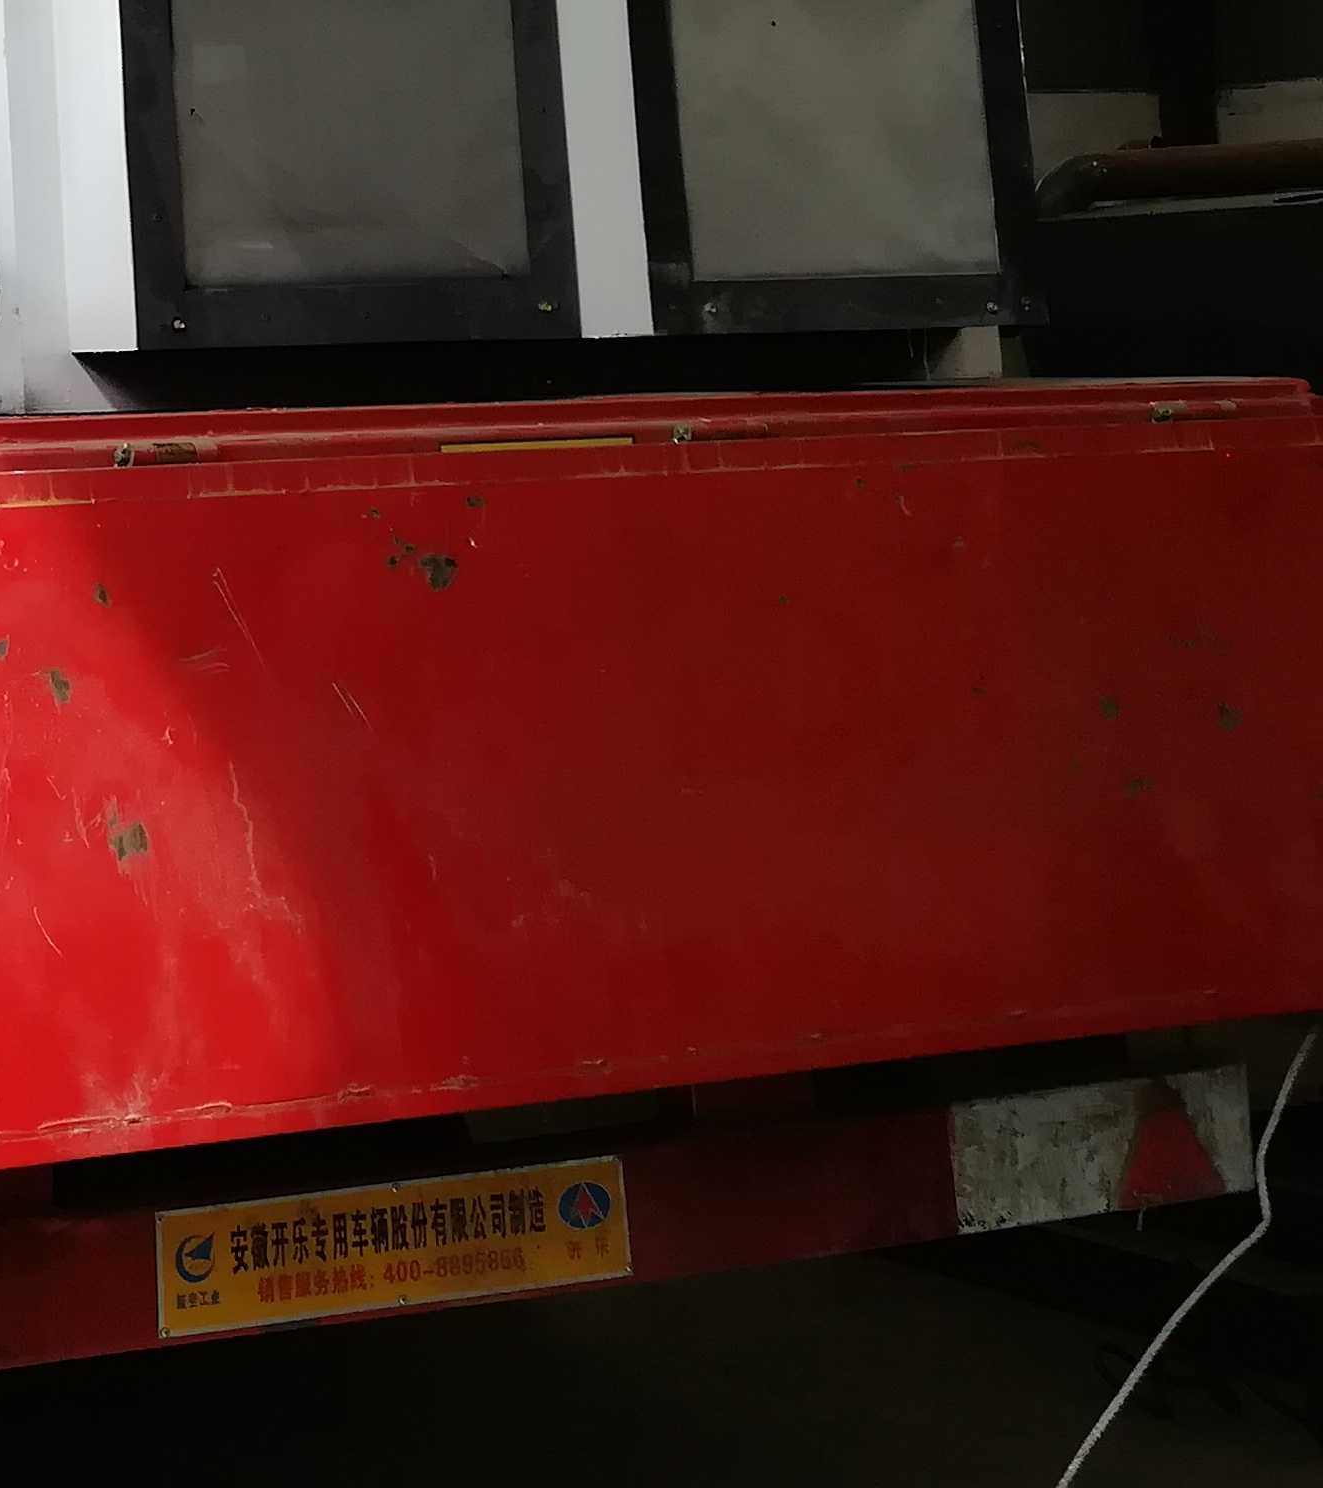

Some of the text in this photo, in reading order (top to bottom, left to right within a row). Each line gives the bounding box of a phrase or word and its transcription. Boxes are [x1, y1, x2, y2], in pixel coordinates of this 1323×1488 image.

[230, 1187, 547, 1273] 安徽开乐专用车辆股份有限公司制造
